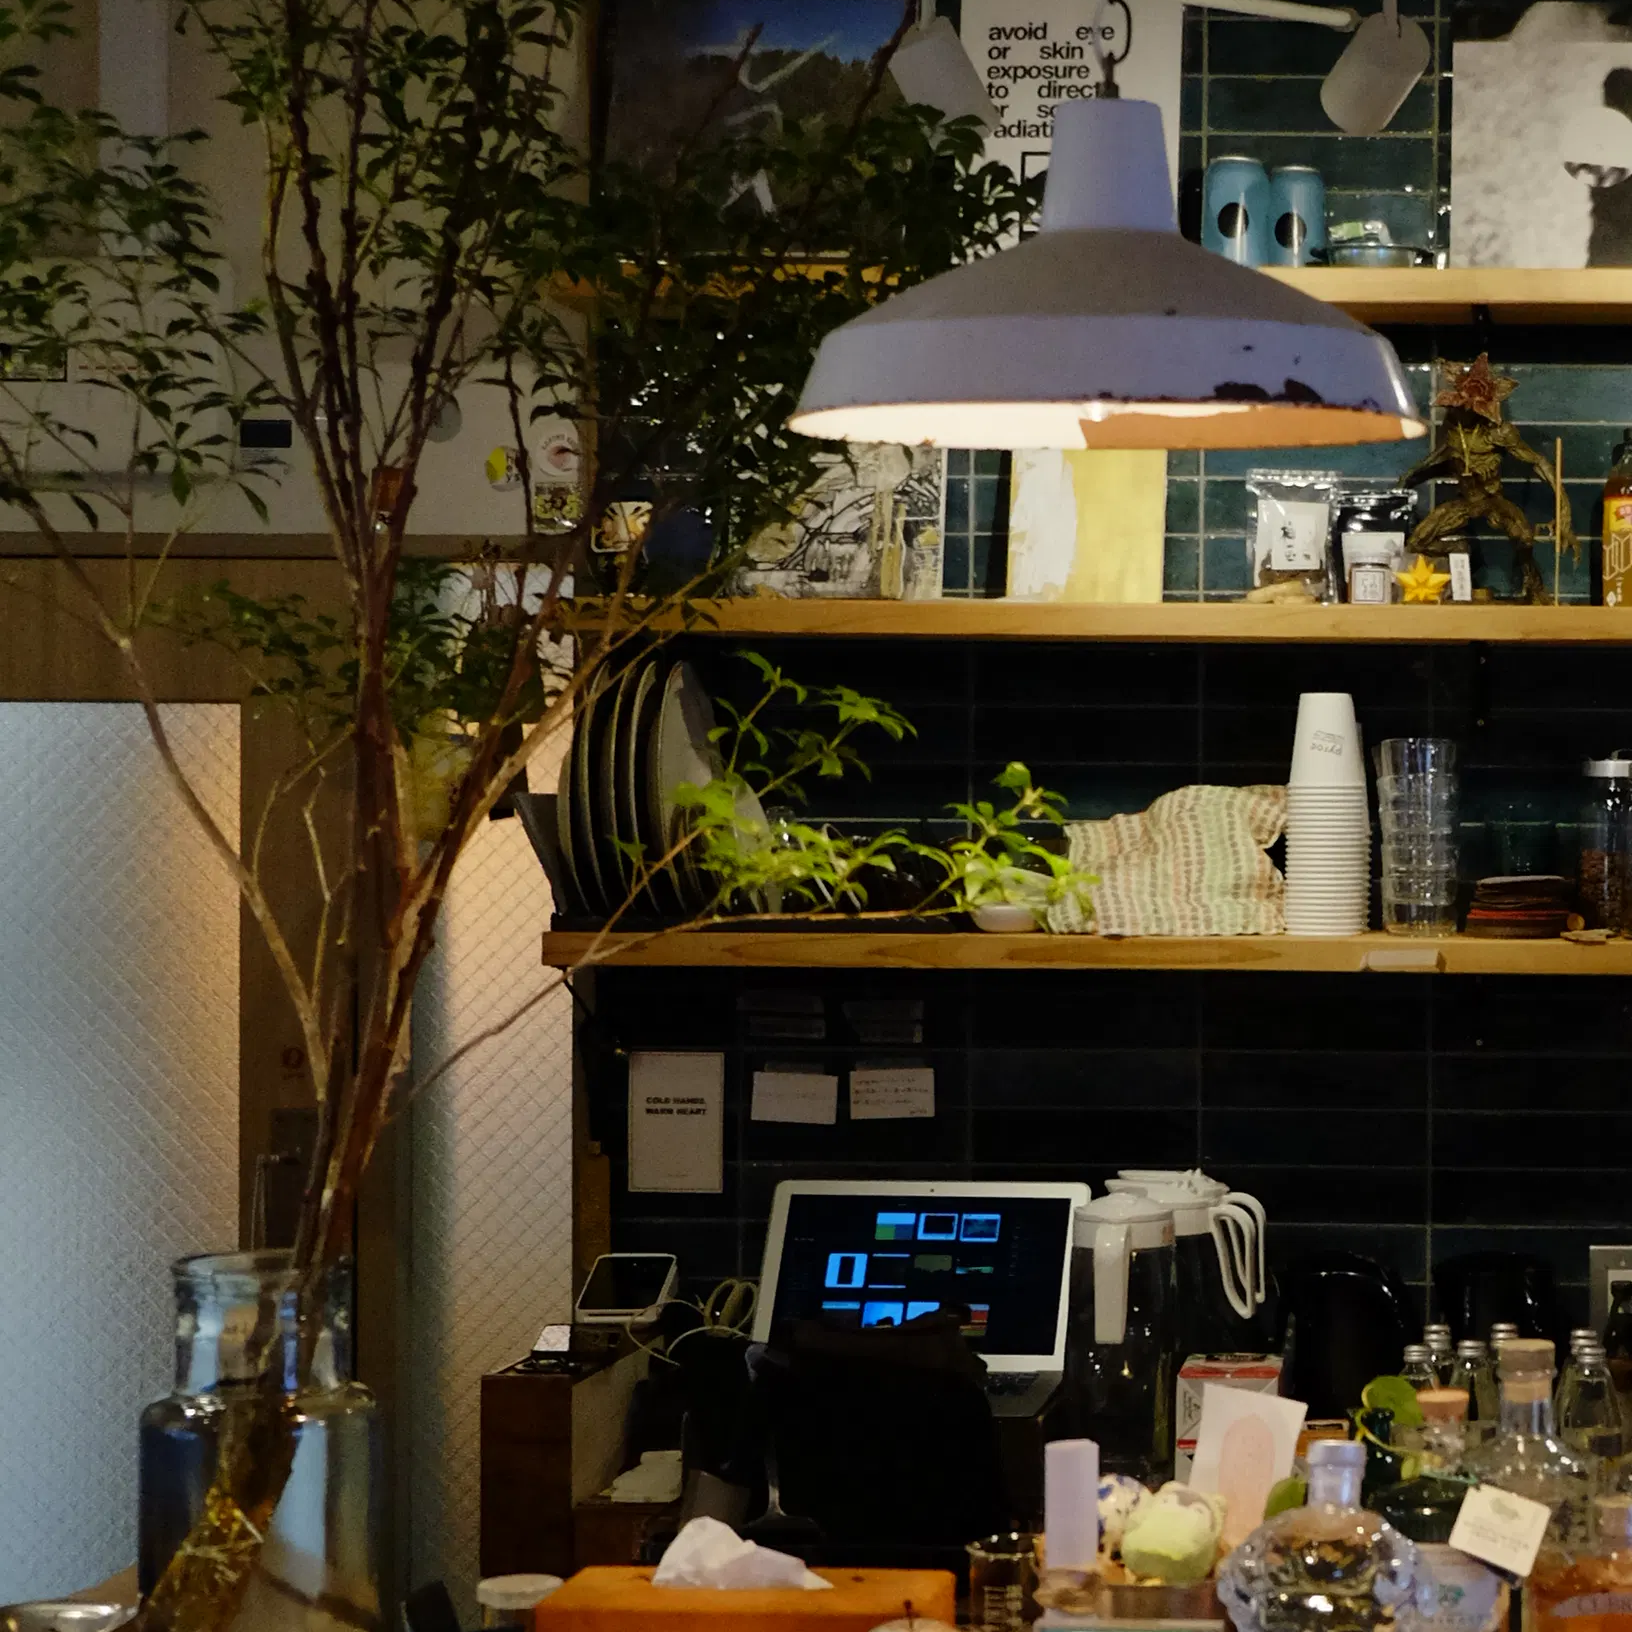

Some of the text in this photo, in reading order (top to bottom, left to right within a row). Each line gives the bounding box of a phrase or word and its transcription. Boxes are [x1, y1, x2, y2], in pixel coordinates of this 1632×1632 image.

[988, 22, 1115, 45] avoid eye
[988, 42, 1084, 60] or skin
[987, 63, 1090, 84] exposure
[987, 81, 1101, 99] to direct
[993, 119, 1054, 138] adiati
